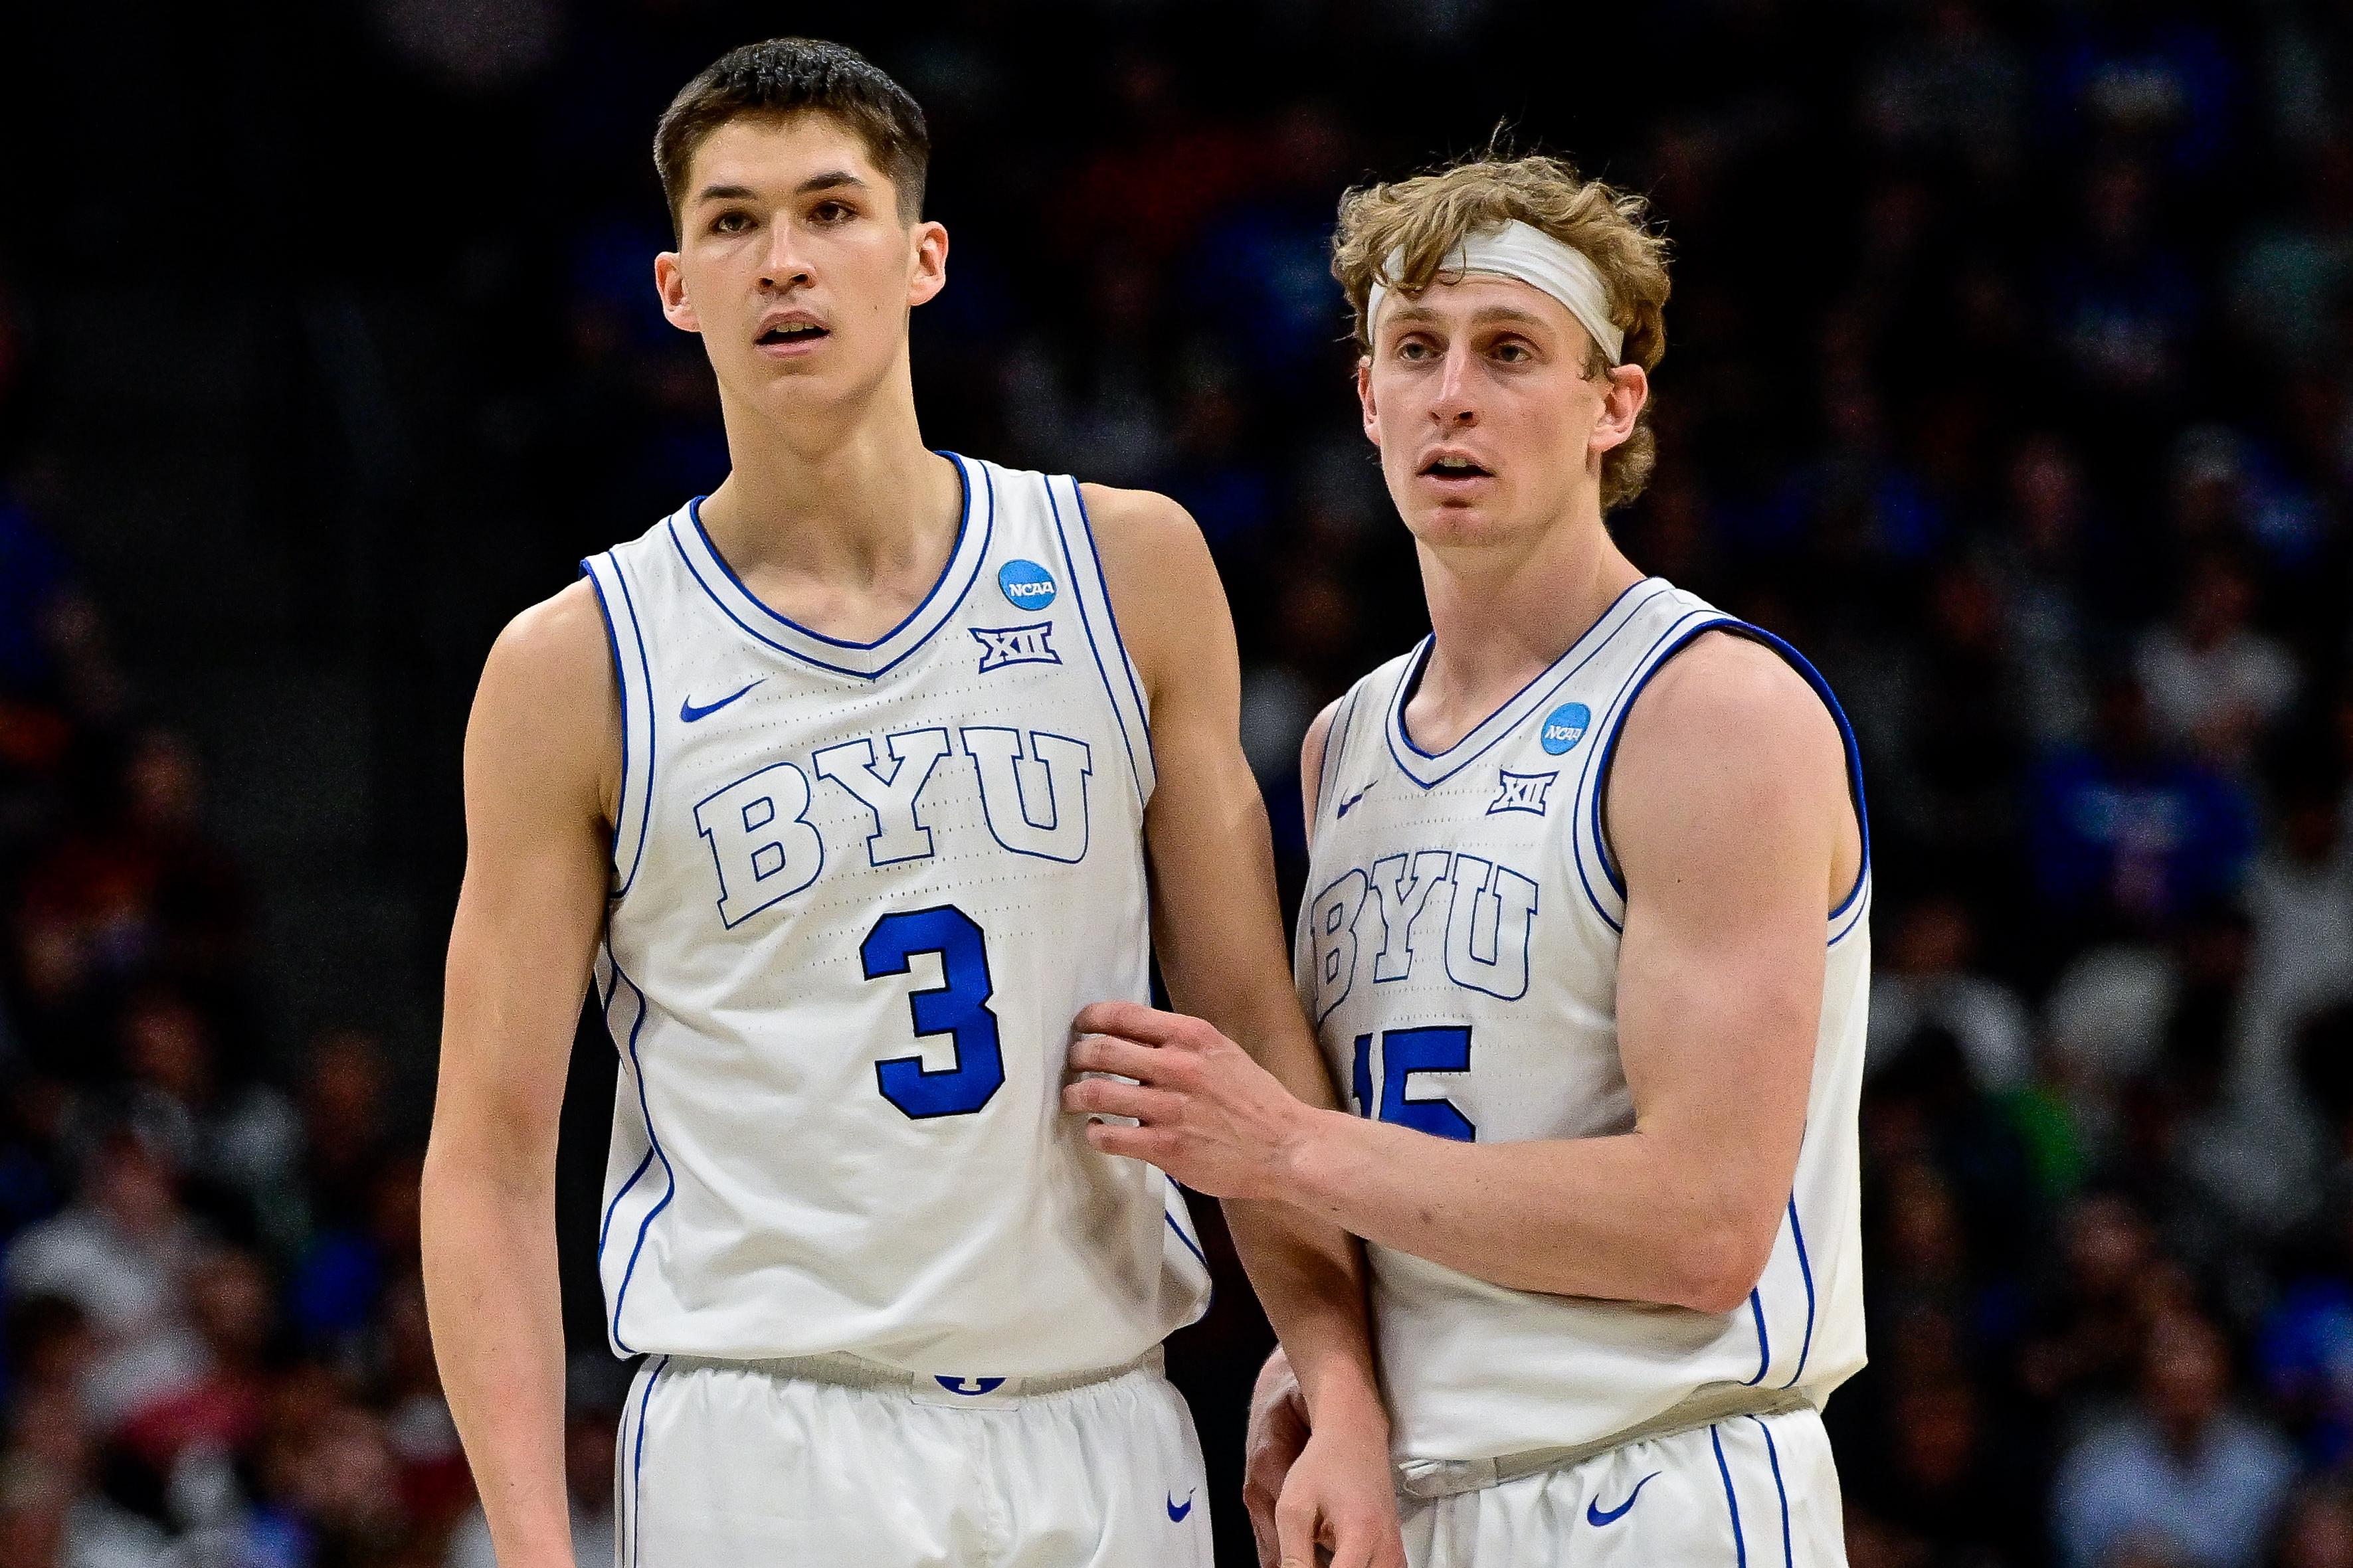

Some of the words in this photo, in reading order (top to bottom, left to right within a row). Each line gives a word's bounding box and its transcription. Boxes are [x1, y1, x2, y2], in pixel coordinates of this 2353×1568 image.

[1008, 581, 1055, 597] NCAA
[967, 620, 1064, 675] XII
[1545, 725, 1584, 741] NCAA
[1485, 769, 1560, 816] XII
[693, 726, 1093, 930] BYU
[1310, 849, 1539, 1028] BYU
[859, 903, 1006, 1120] 3
